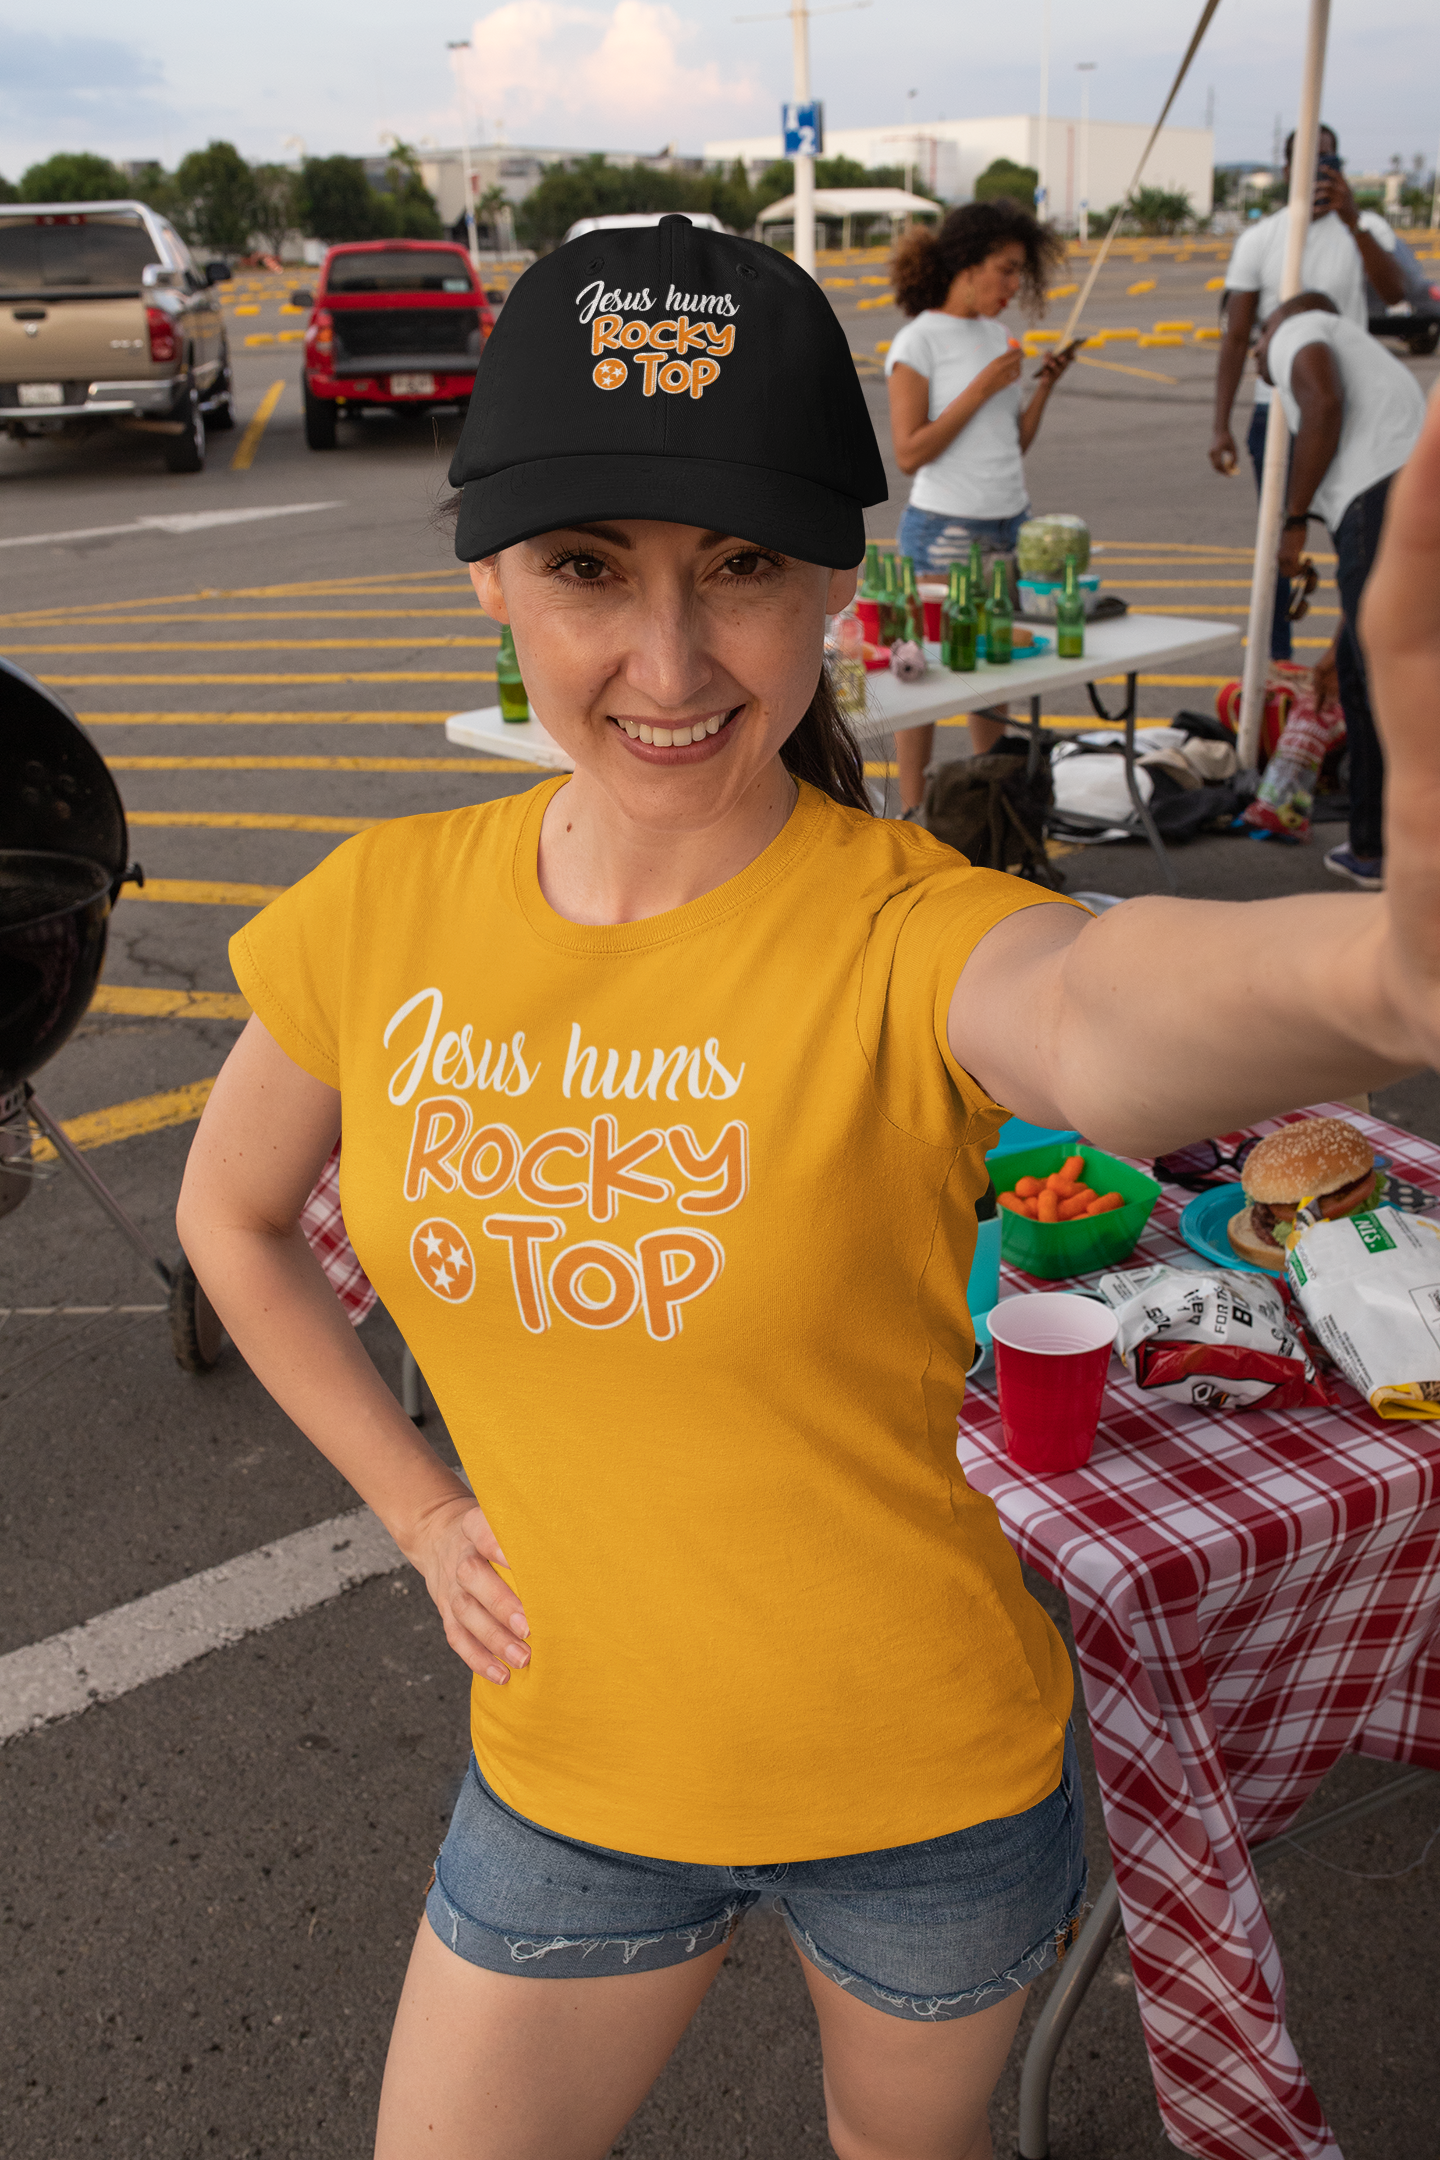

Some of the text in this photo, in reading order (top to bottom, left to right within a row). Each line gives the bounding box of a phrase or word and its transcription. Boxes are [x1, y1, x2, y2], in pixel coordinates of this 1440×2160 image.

[575, 280, 741, 325] Jesus hums
[383, 987, 746, 1106] Jesus hums
